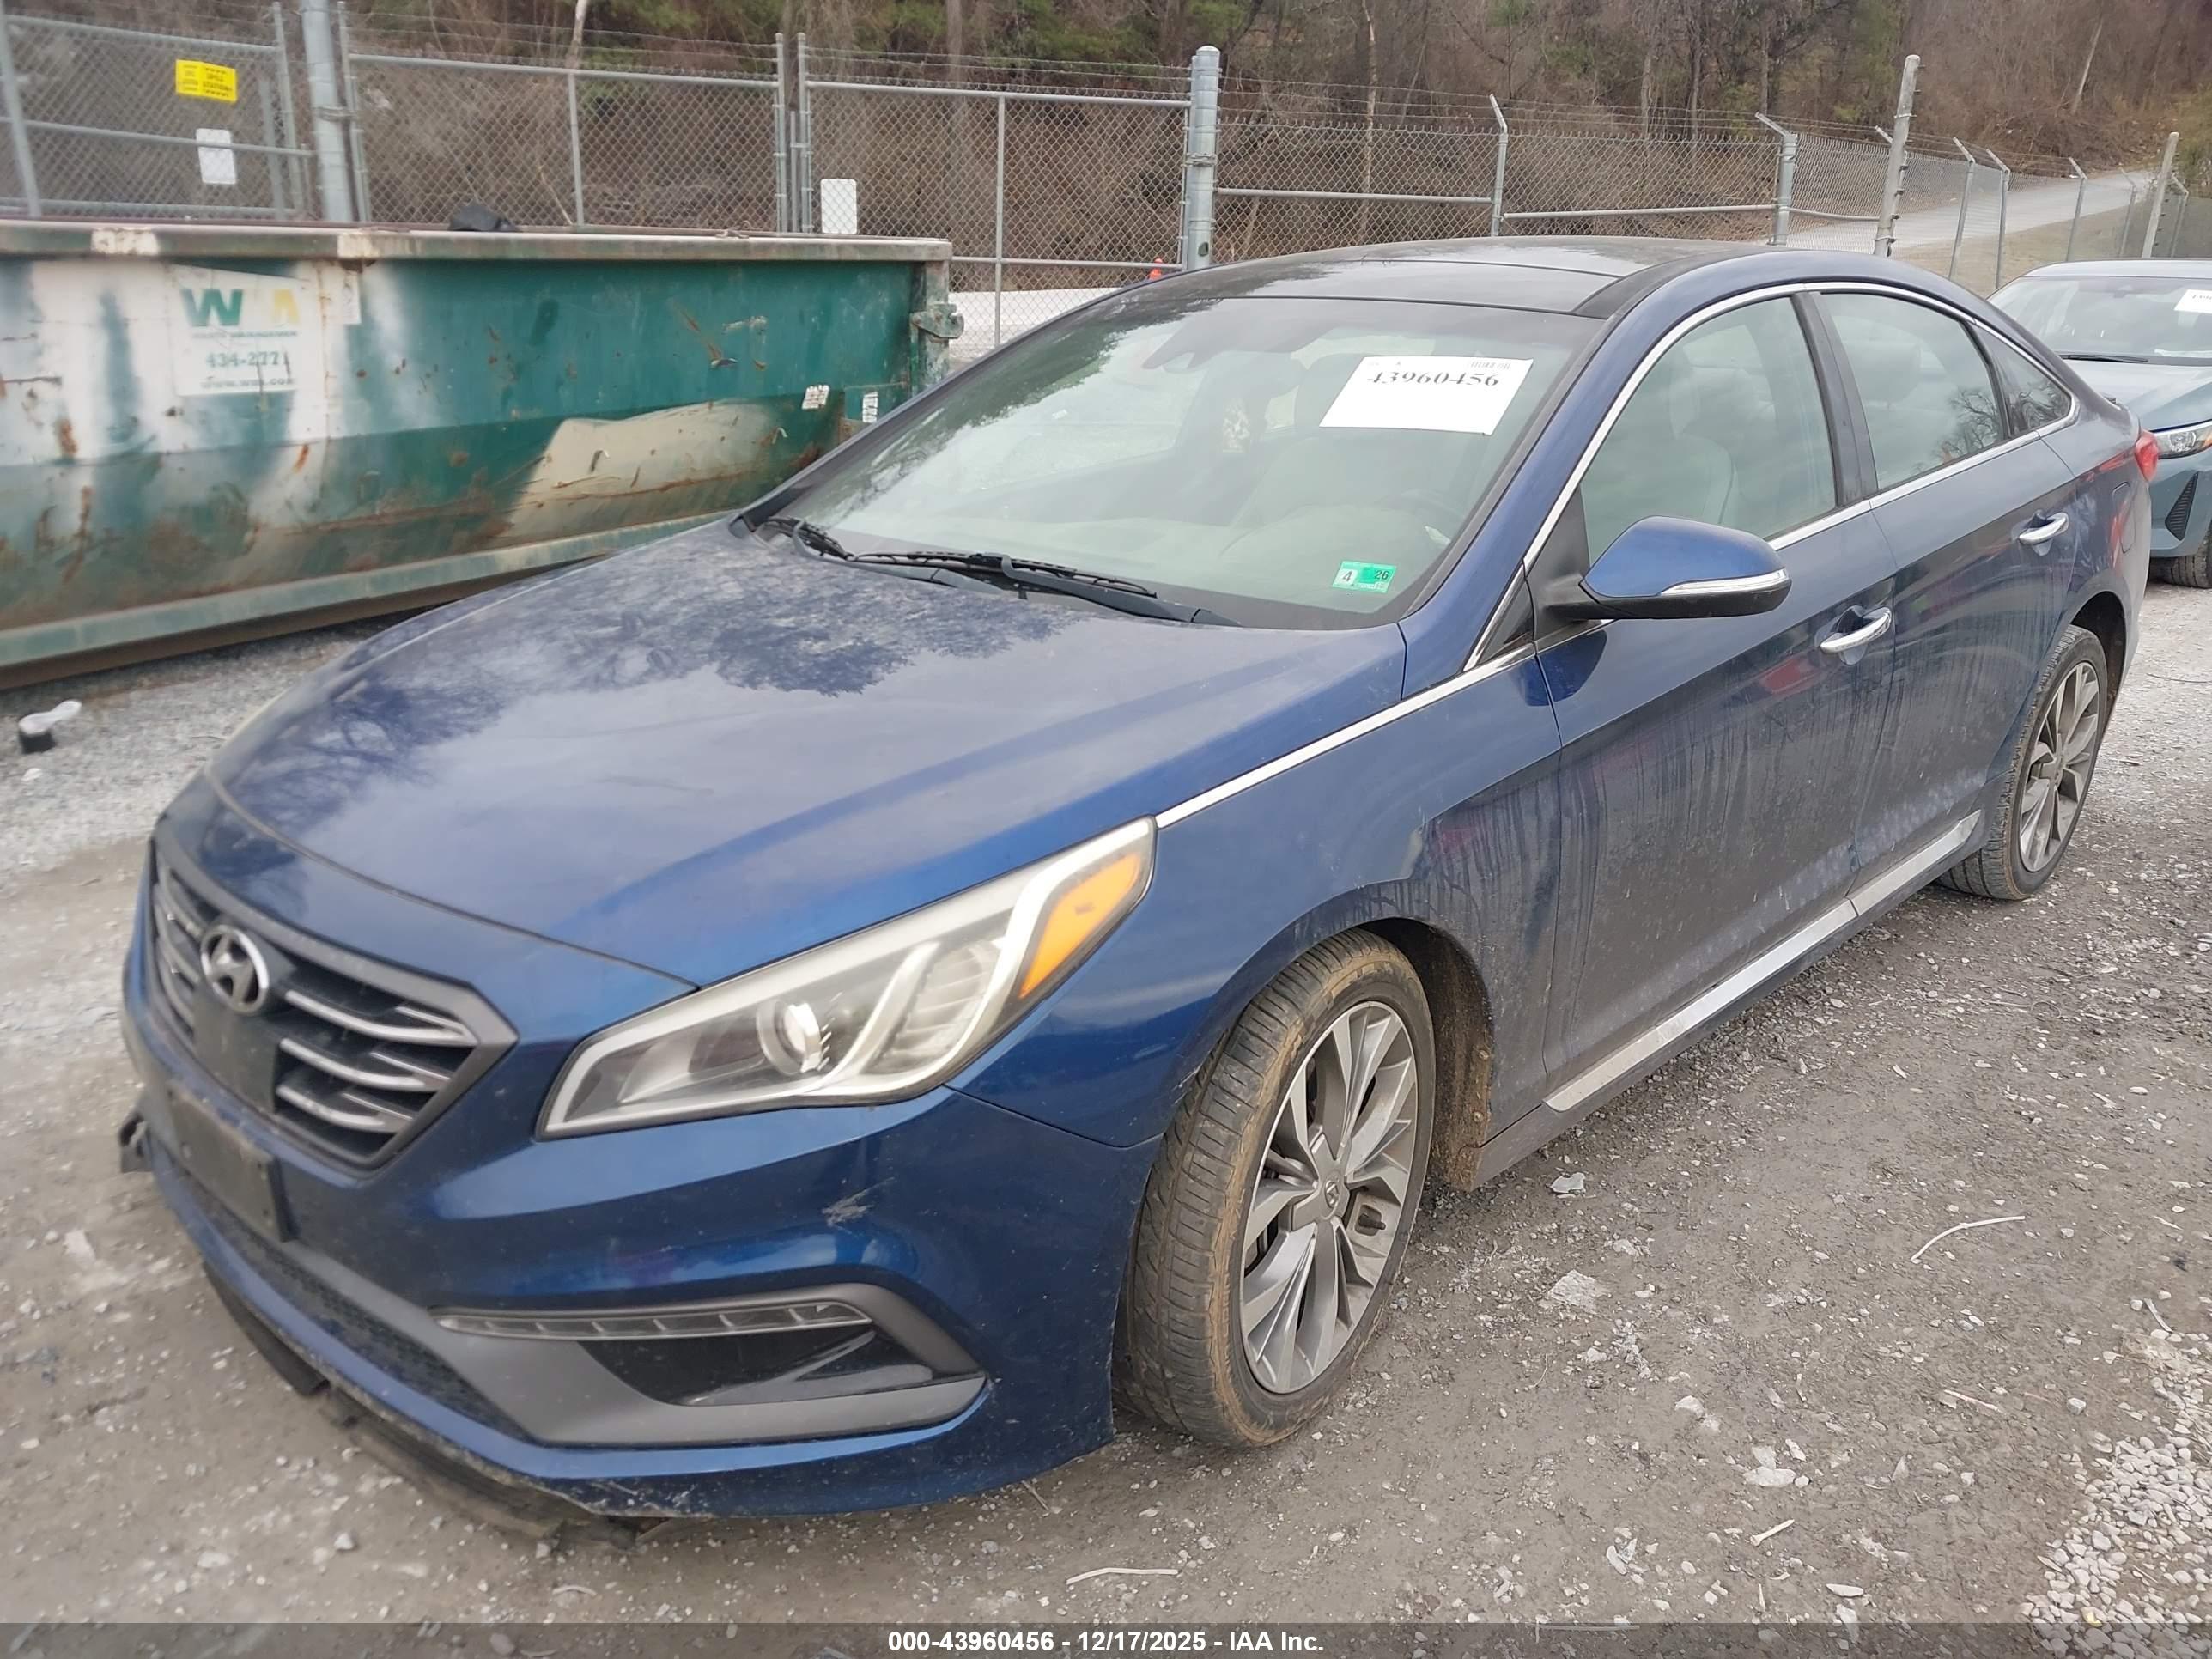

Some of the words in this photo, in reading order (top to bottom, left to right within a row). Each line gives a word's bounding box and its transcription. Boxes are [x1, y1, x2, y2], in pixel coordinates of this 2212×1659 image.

[1367, 371, 1499, 386] 43960456
[1342, 570, 1353, 582] 4
[1374, 569, 1390, 580] 26
